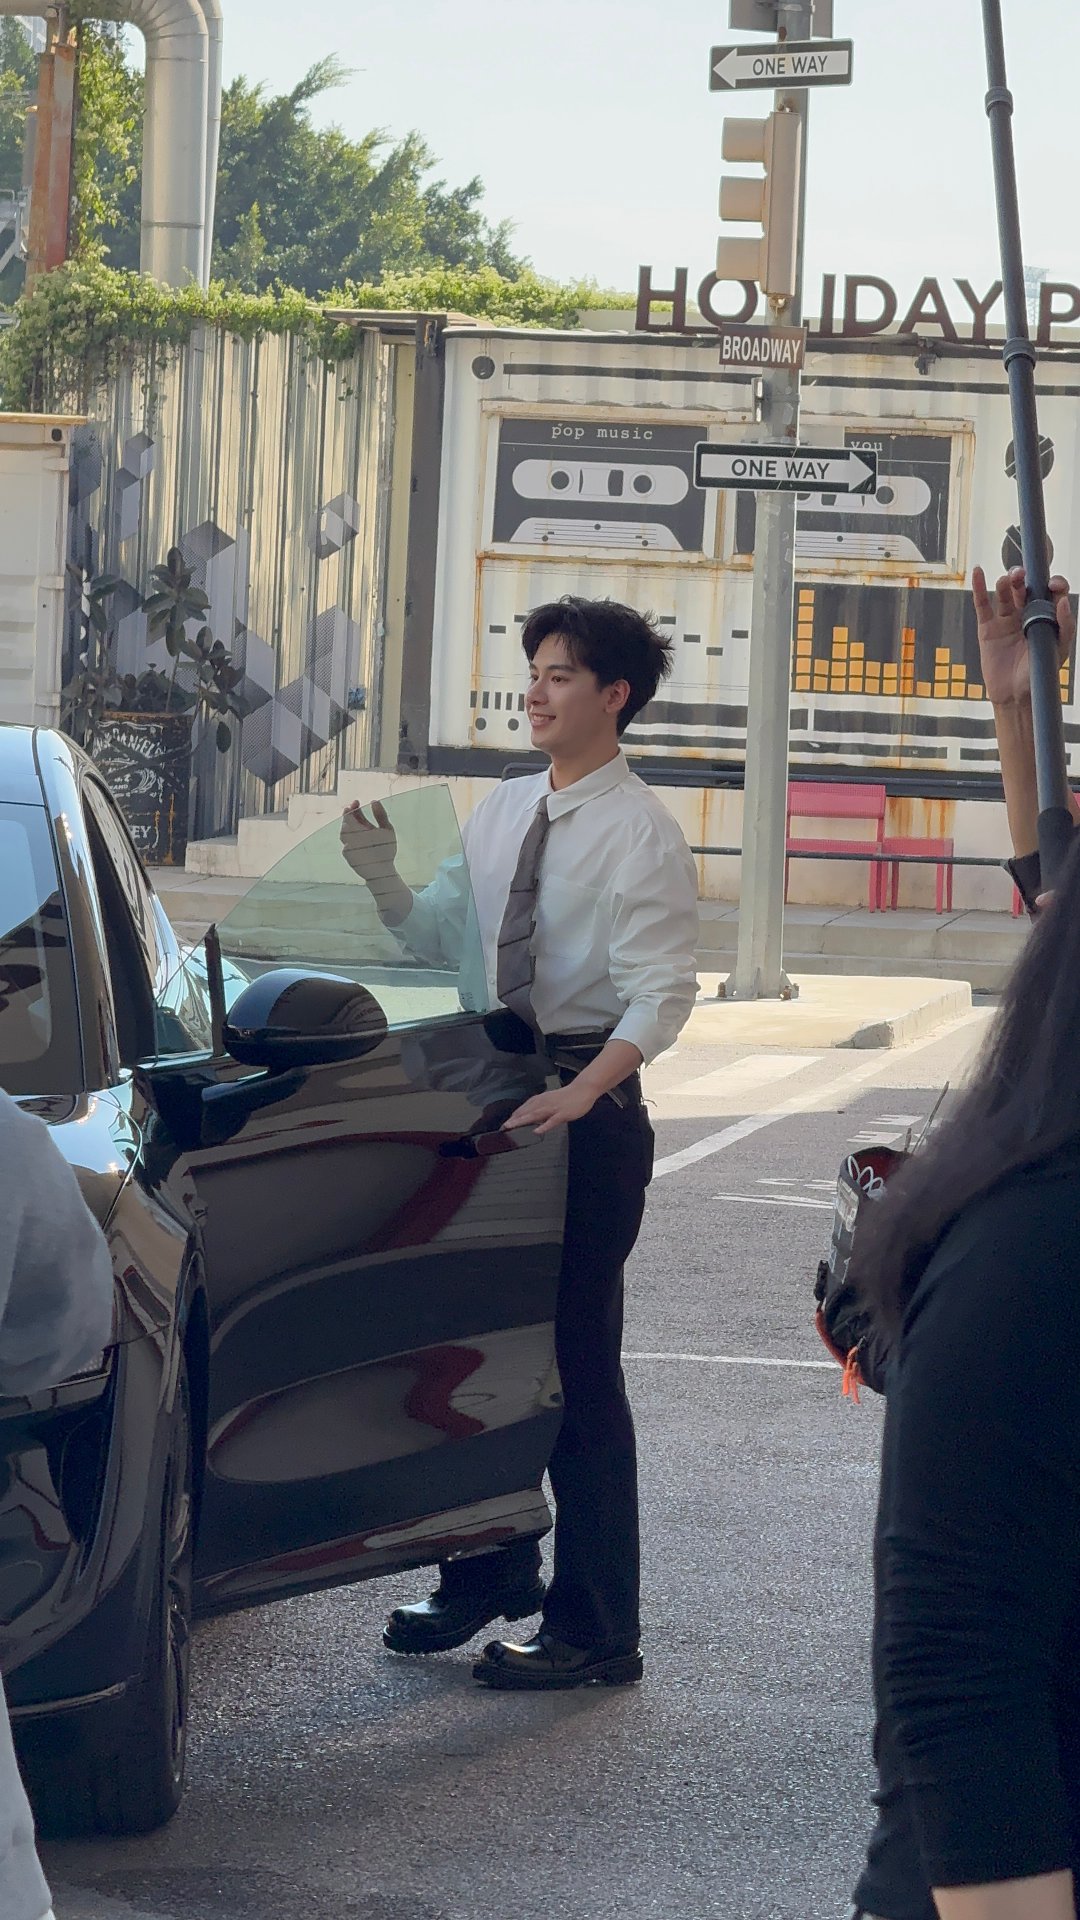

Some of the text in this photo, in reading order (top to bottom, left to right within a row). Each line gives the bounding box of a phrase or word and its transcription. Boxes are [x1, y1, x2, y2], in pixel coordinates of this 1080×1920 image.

[752, 55, 828, 76] ONE WAY
[635, 265, 1003, 345] HOIDAY
[722, 335, 801, 364] BROADWAY
[551, 426, 653, 440] pop music
[850, 440, 883, 451] you
[731, 458, 831, 480] ONE WAY
